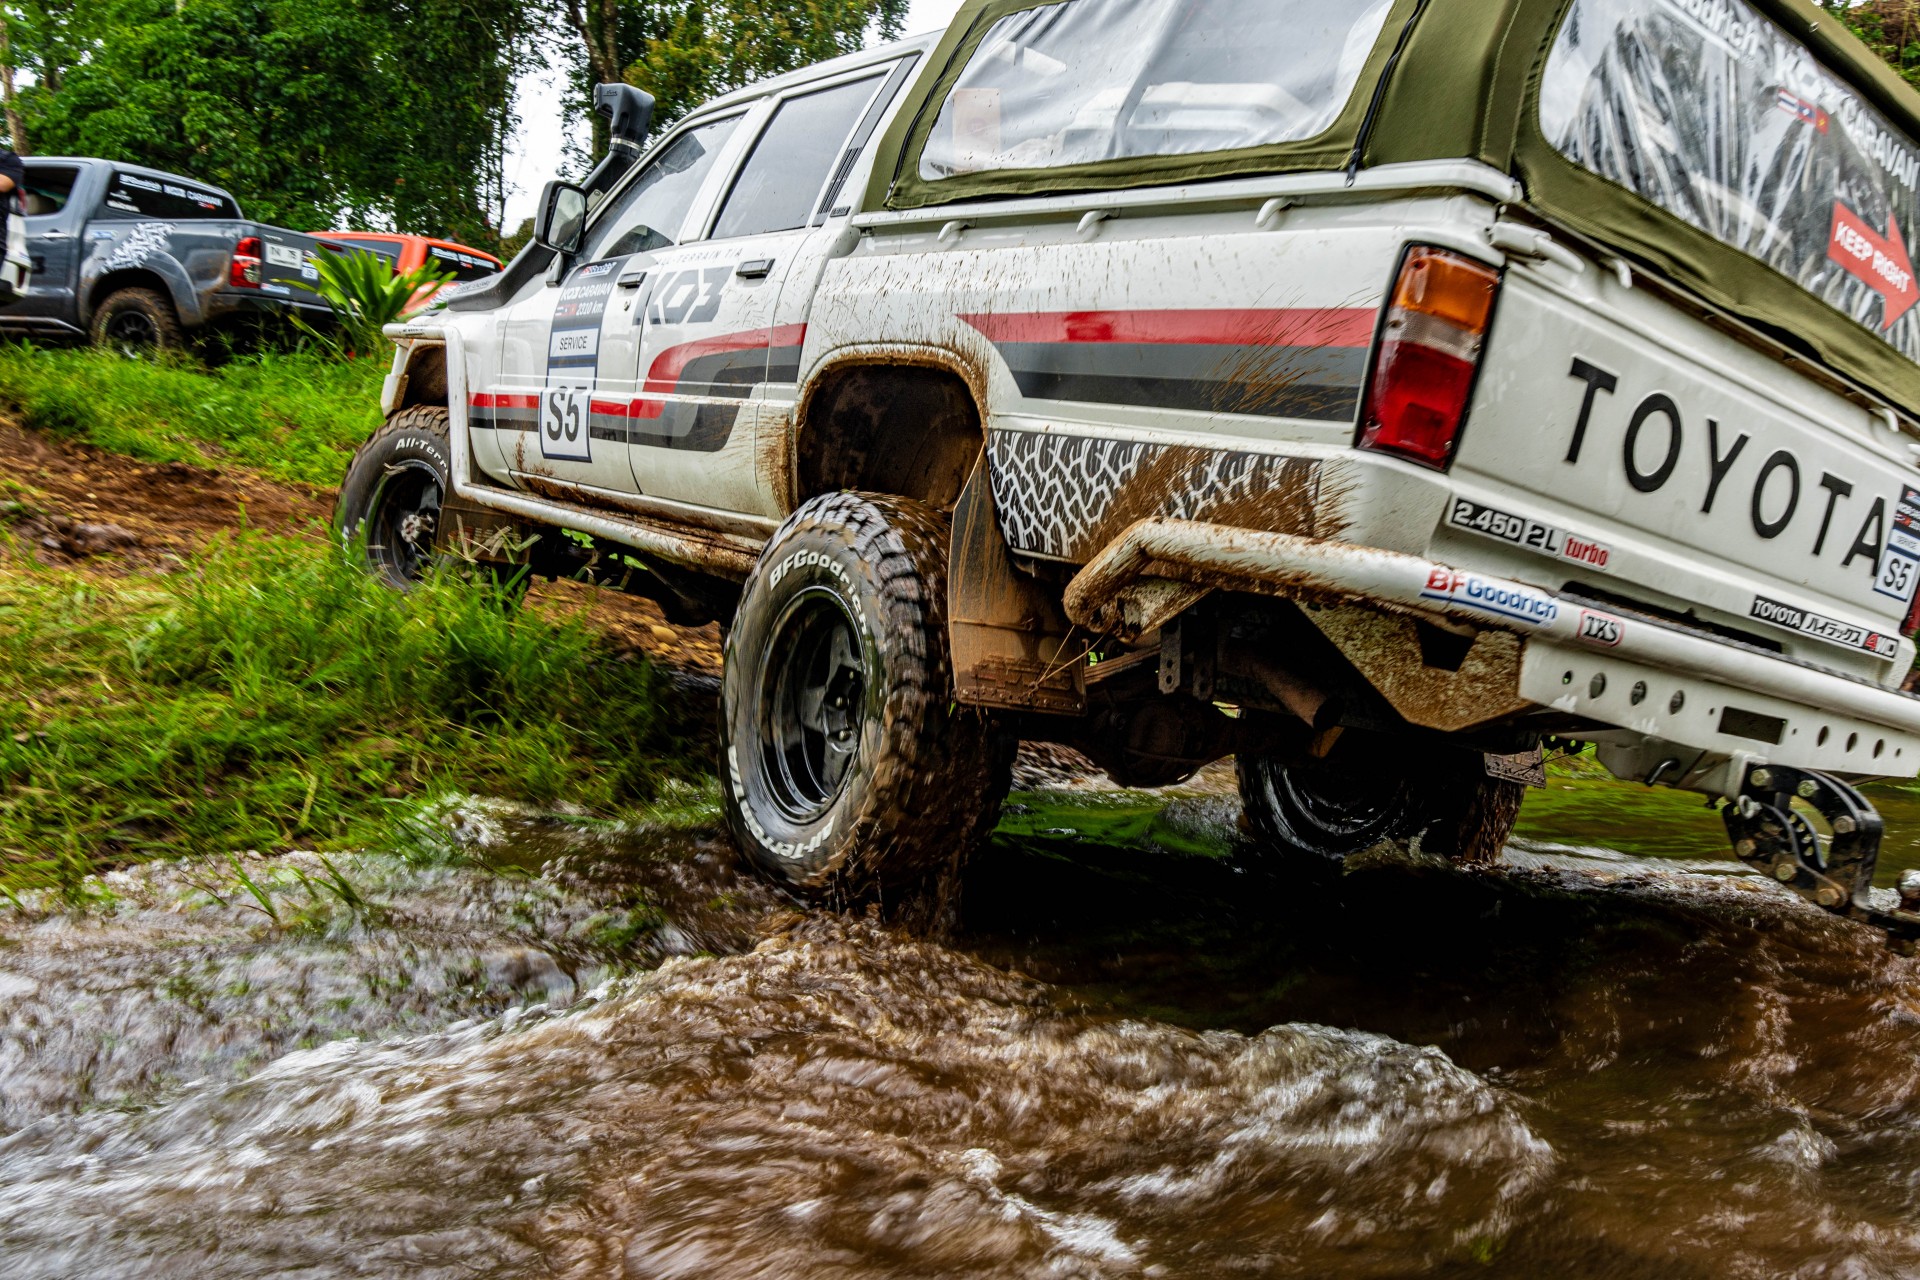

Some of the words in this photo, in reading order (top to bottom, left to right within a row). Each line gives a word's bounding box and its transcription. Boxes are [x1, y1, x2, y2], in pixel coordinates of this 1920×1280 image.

[1834, 221, 1873, 261] KEEP
[1872, 249, 1911, 293] RIGHT
[578, 282, 614, 299] CARAVAN
[559, 335, 588, 351] SERVICE
[546, 385, 588, 442] S5
[1565, 355, 1886, 577] TOYOTA
[1454, 502, 1523, 541] 2.45D
[1564, 537, 1609, 567] turbo
[770, 548, 867, 636] BFGoodrich
[1883, 557, 1912, 592] S5
[1754, 599, 1802, 628] TOYOTA
[1864, 633, 1899, 657] 4WD
